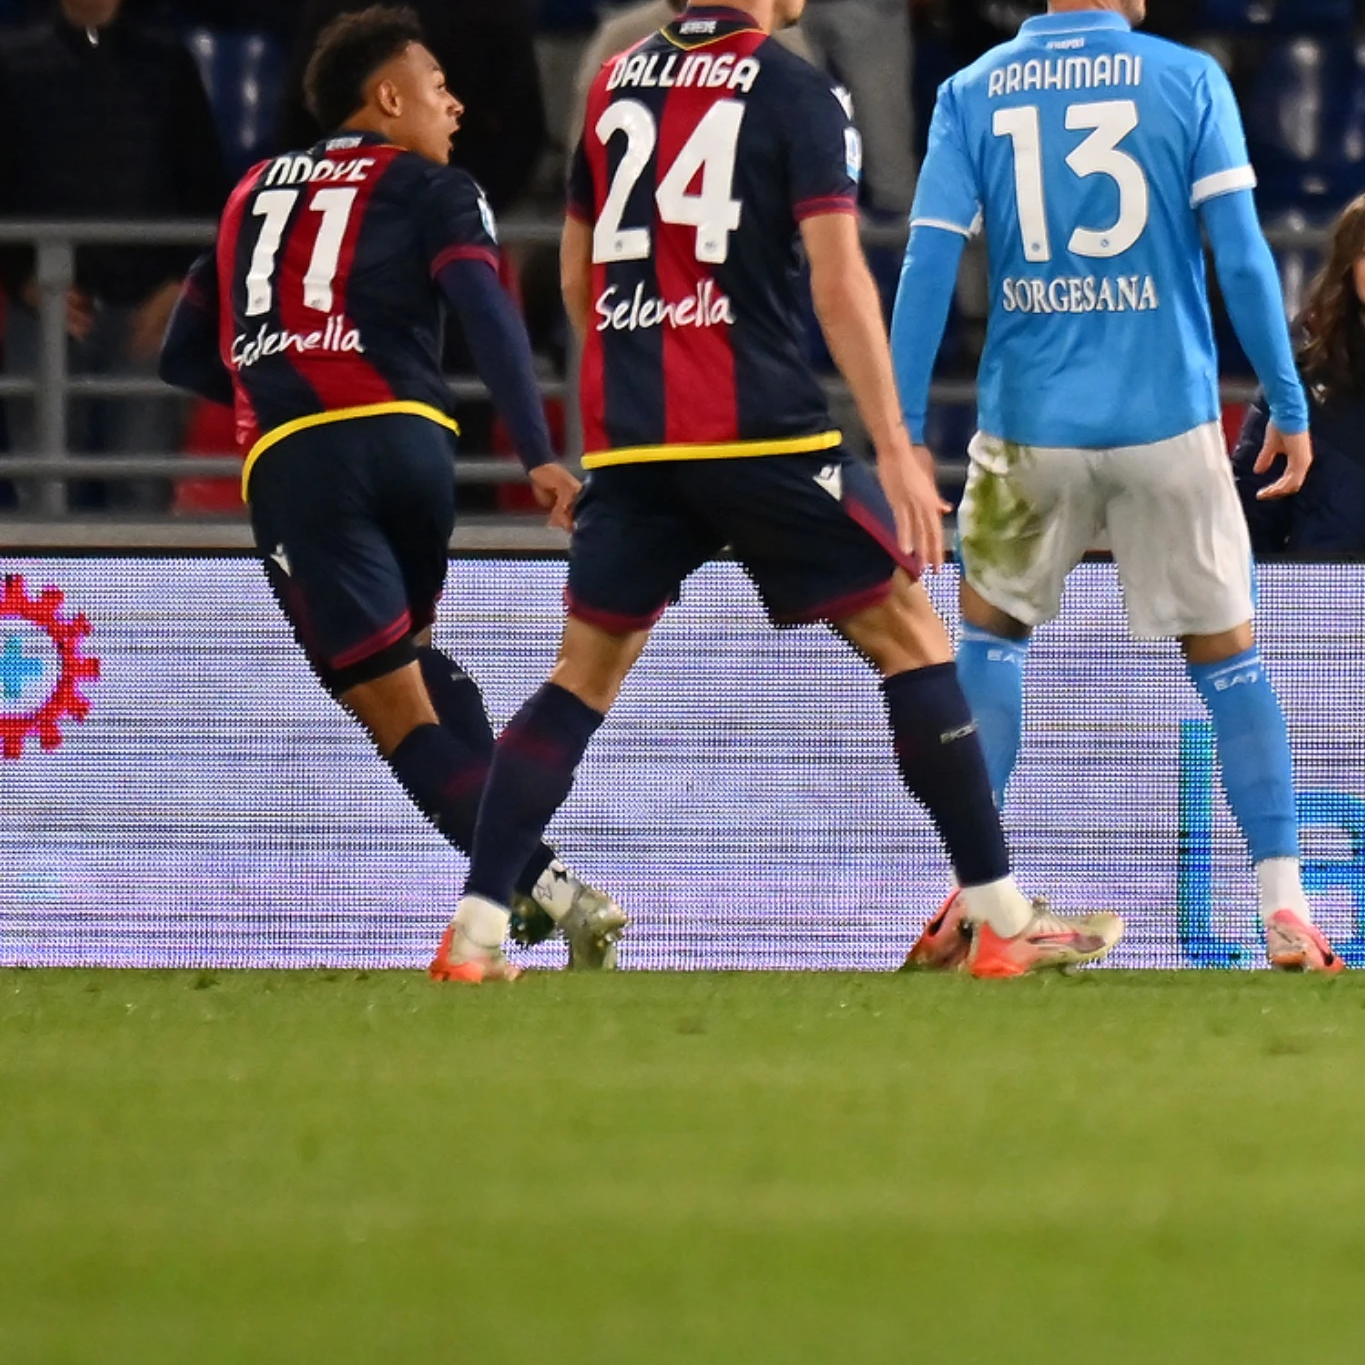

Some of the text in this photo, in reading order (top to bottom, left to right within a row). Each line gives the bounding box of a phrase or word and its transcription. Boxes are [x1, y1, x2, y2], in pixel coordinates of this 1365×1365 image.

[606, 52, 760, 93] DALLINGA
[988, 54, 1142, 98] RRAHMANI
[264, 155, 376, 186] NDOYE
[593, 98, 746, 264] 24
[993, 100, 1148, 262] 13
[245, 187, 358, 316] 11
[595, 280, 734, 331] Selenella
[1002, 275, 1159, 314] SORGESANA
